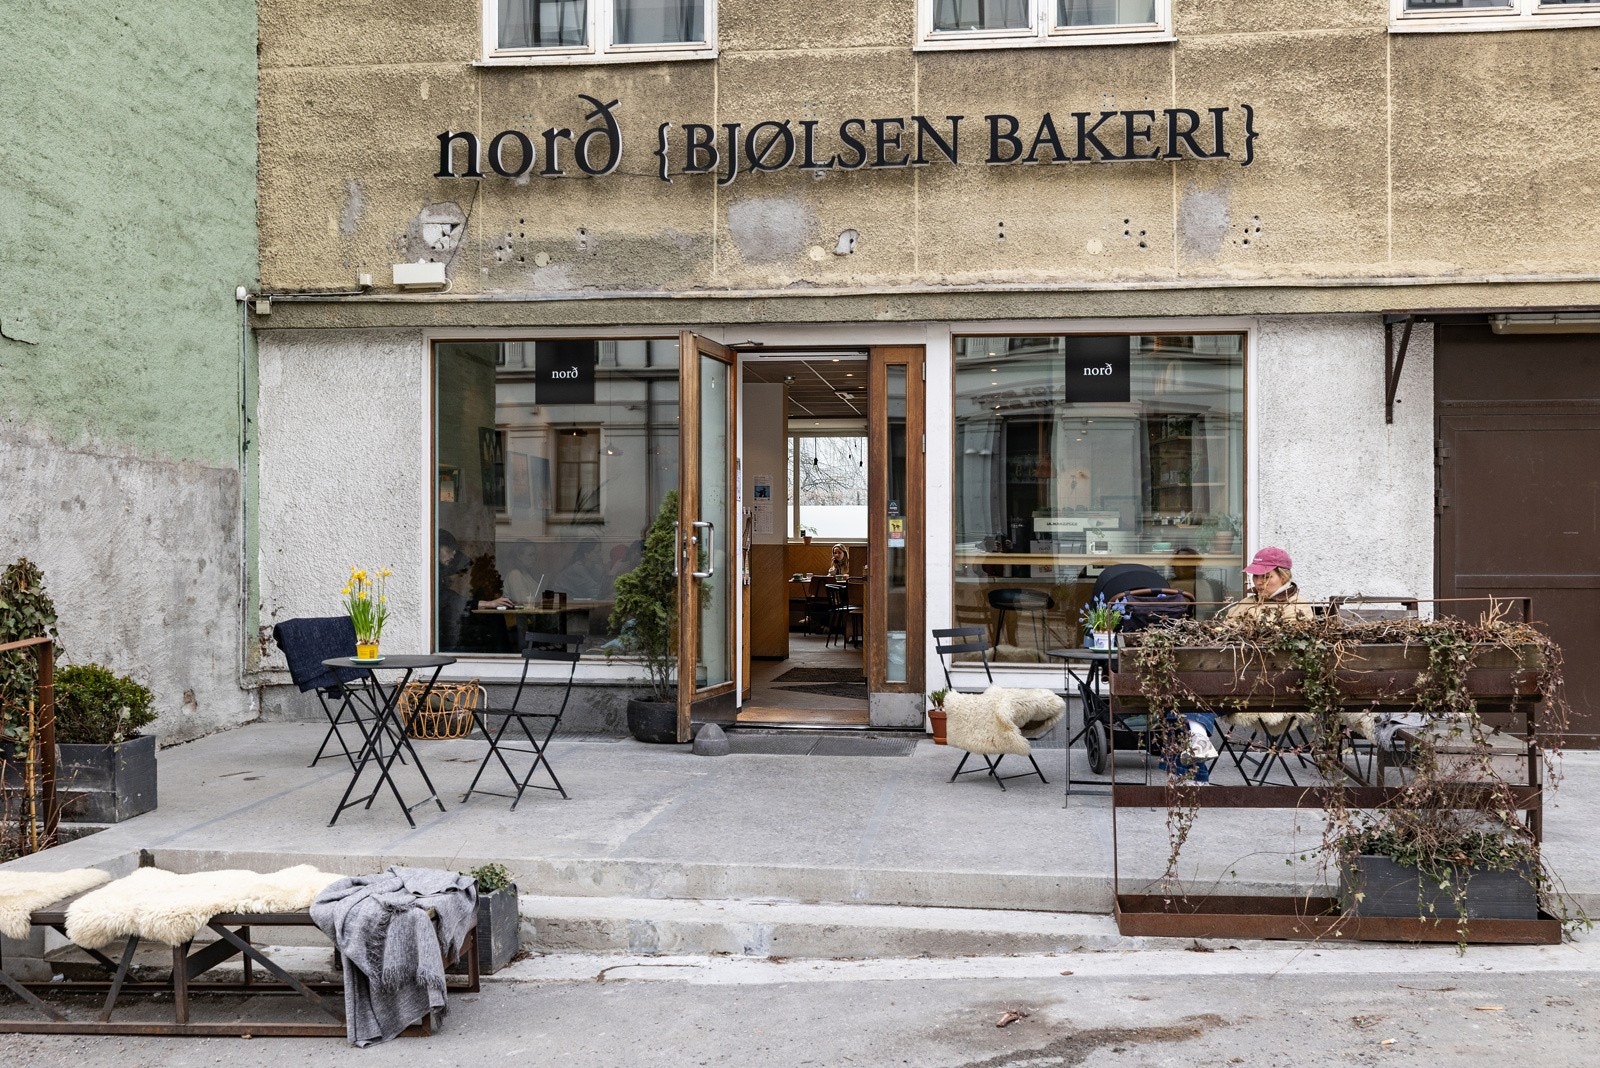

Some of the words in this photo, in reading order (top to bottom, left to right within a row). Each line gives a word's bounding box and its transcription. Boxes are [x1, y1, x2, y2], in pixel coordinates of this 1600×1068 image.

[434, 94, 622, 178] norð
[551, 366, 579, 379] norð
[1083, 362, 1113, 376] norð
